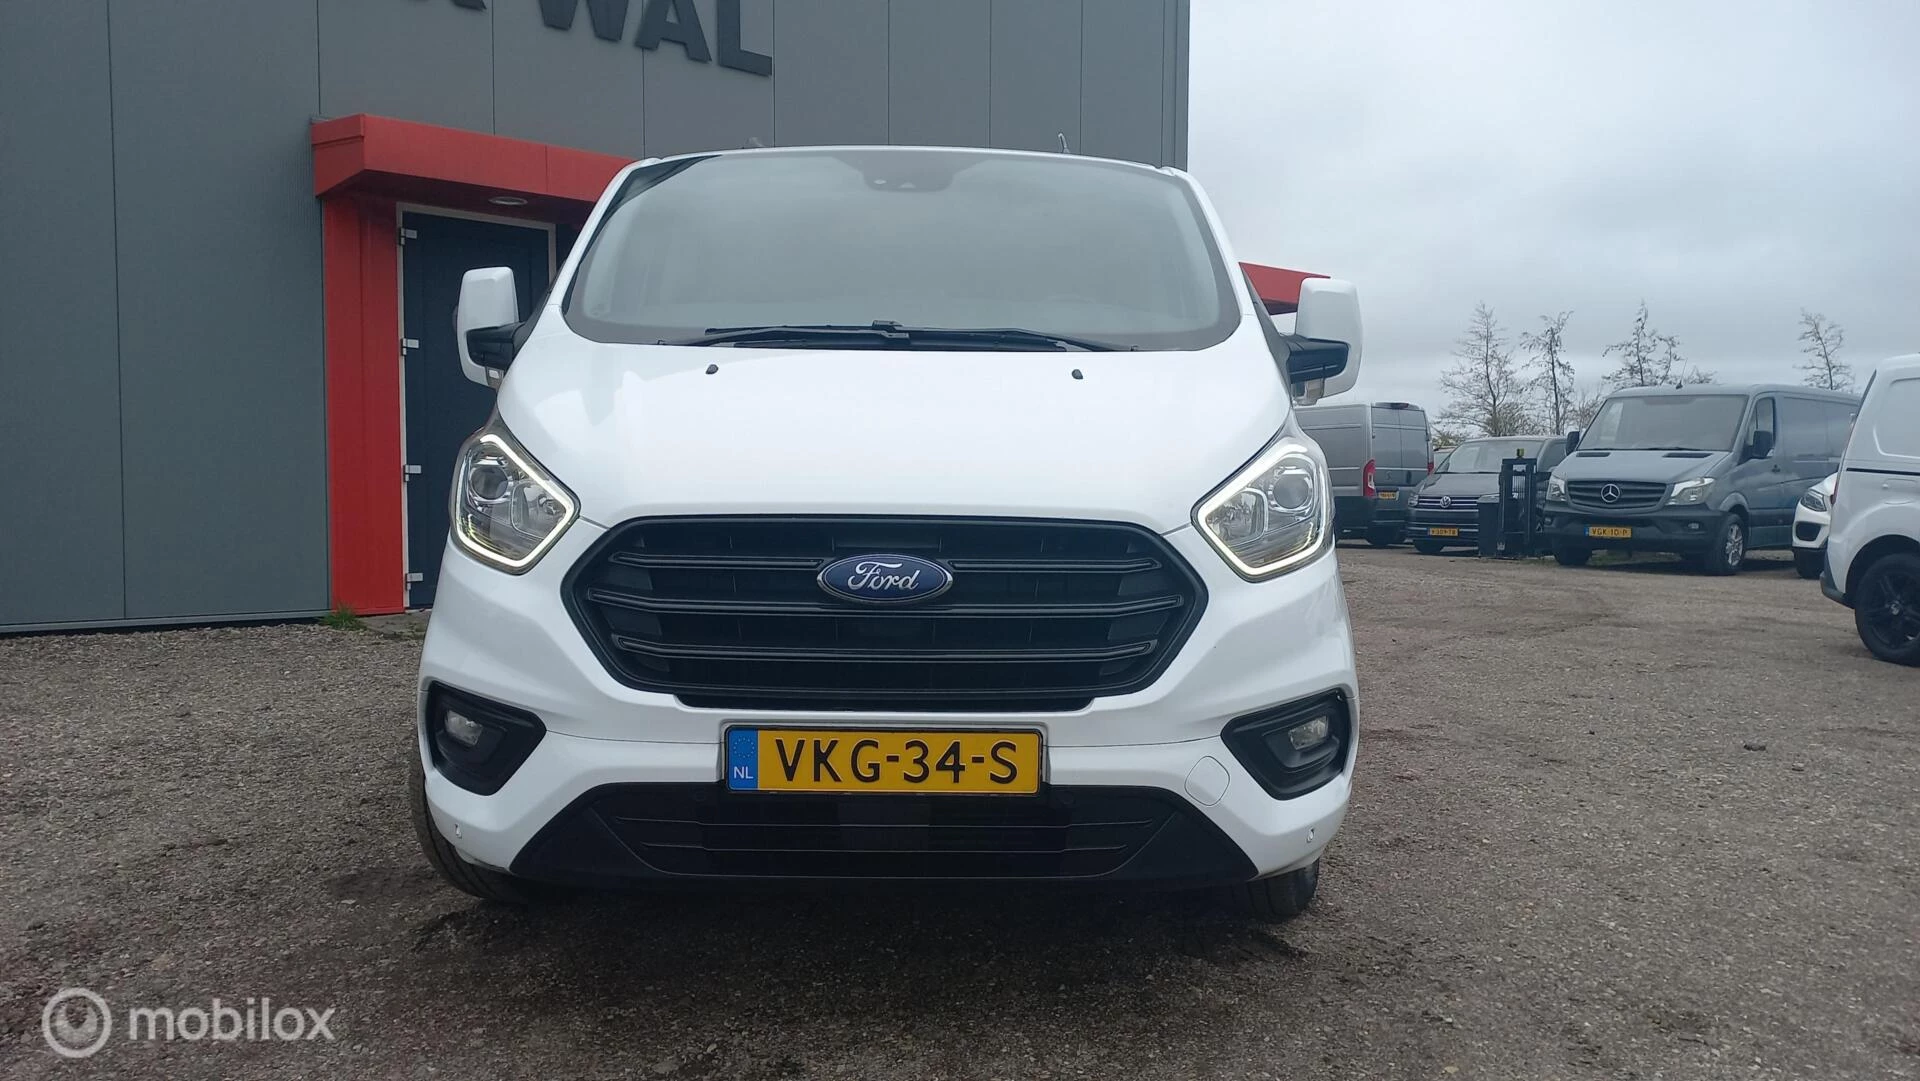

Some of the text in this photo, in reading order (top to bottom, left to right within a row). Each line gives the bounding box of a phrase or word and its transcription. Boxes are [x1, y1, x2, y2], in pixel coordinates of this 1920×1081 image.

[847, 561, 921, 590] Ford
[733, 766, 754, 779] NL
[775, 738, 1019, 784] VKG-34-S
